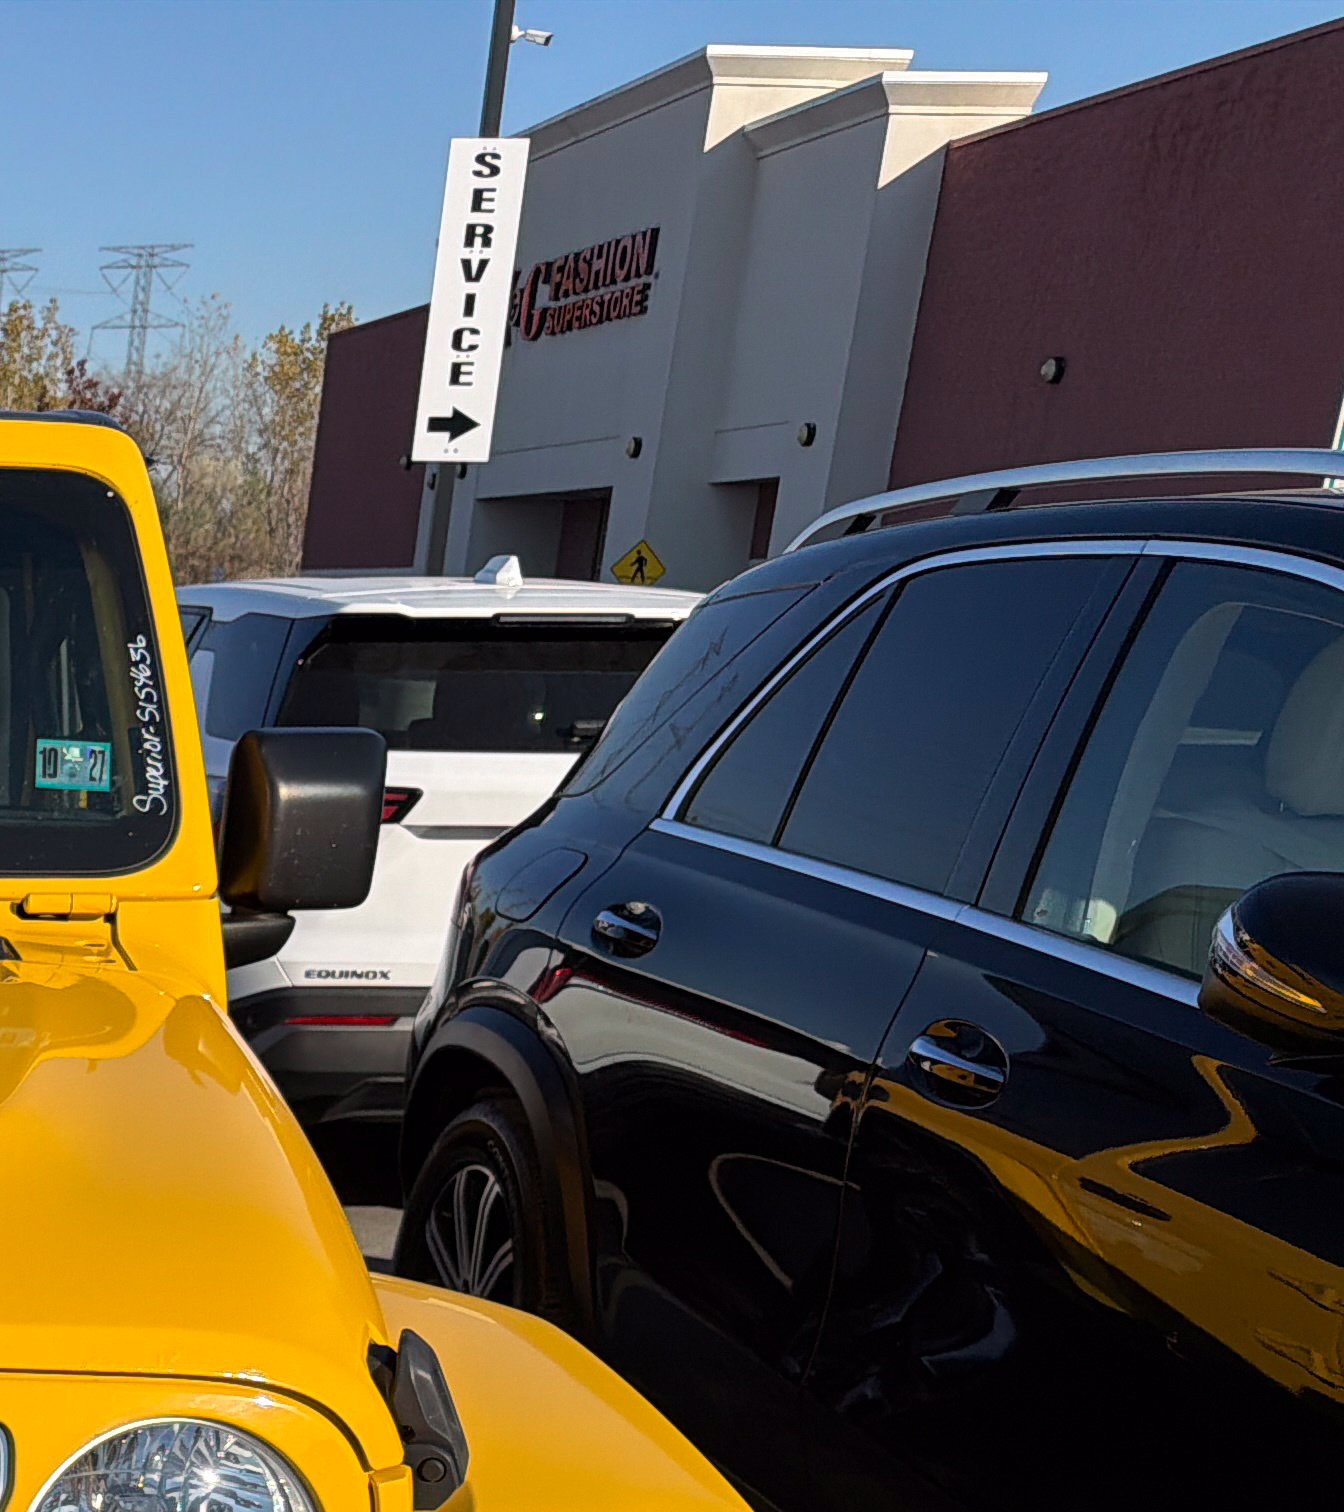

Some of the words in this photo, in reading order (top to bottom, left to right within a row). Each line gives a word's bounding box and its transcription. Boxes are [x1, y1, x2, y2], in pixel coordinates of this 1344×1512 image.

[448, 151, 502, 387] SERVICE
[548, 228, 655, 302] FASHION
[544, 282, 646, 336] SUPERSTORE
[88, 748, 106, 784] 27
[304, 968, 391, 981] EQUINOX
